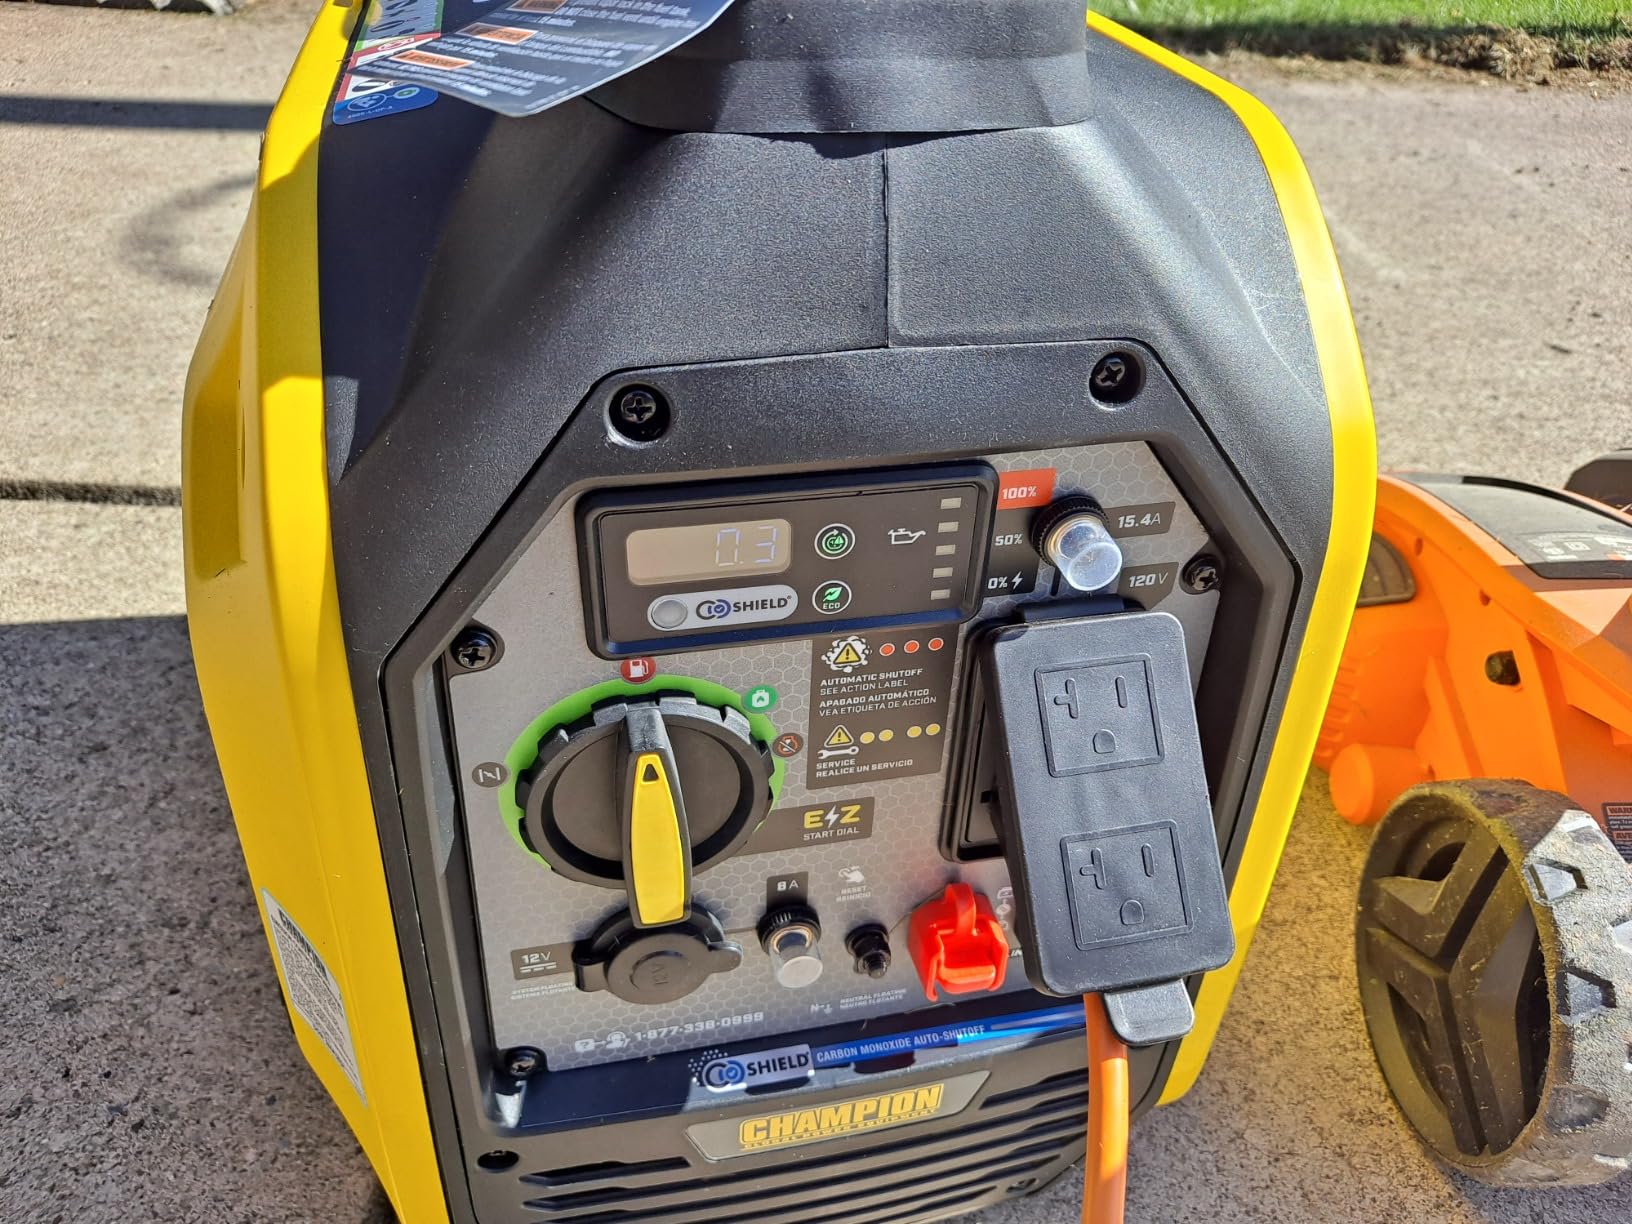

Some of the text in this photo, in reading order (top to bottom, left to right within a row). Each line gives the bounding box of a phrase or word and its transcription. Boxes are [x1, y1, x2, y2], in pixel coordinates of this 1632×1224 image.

[1002, 486, 1037, 500] 100%
[995, 533, 1022, 546] 50%
[988, 576, 1008, 589] 0%
[822, 601, 841, 610] ECO
[820, 668, 923, 687] AUTOMATIC SHUTOFF
[820, 679, 908, 696] SEE ACTION LABEL
[868, 688, 929, 702] AUTOMÁTICO
[819, 696, 937, 717] VEA ETIQUETA DE ACCIÓN
[816, 758, 856, 770] SERVICE
[816, 759, 913, 778] REALICE UN SERVICIO
[803, 827, 860, 841] START DIAL
[816, 1047, 858, 1062] CARBON
[860, 1037, 912, 1055] MONOXIDE
[913, 1024, 986, 1046] AUTO-SHUTOFF
[741, 1085, 943, 1144] CHAMPION
